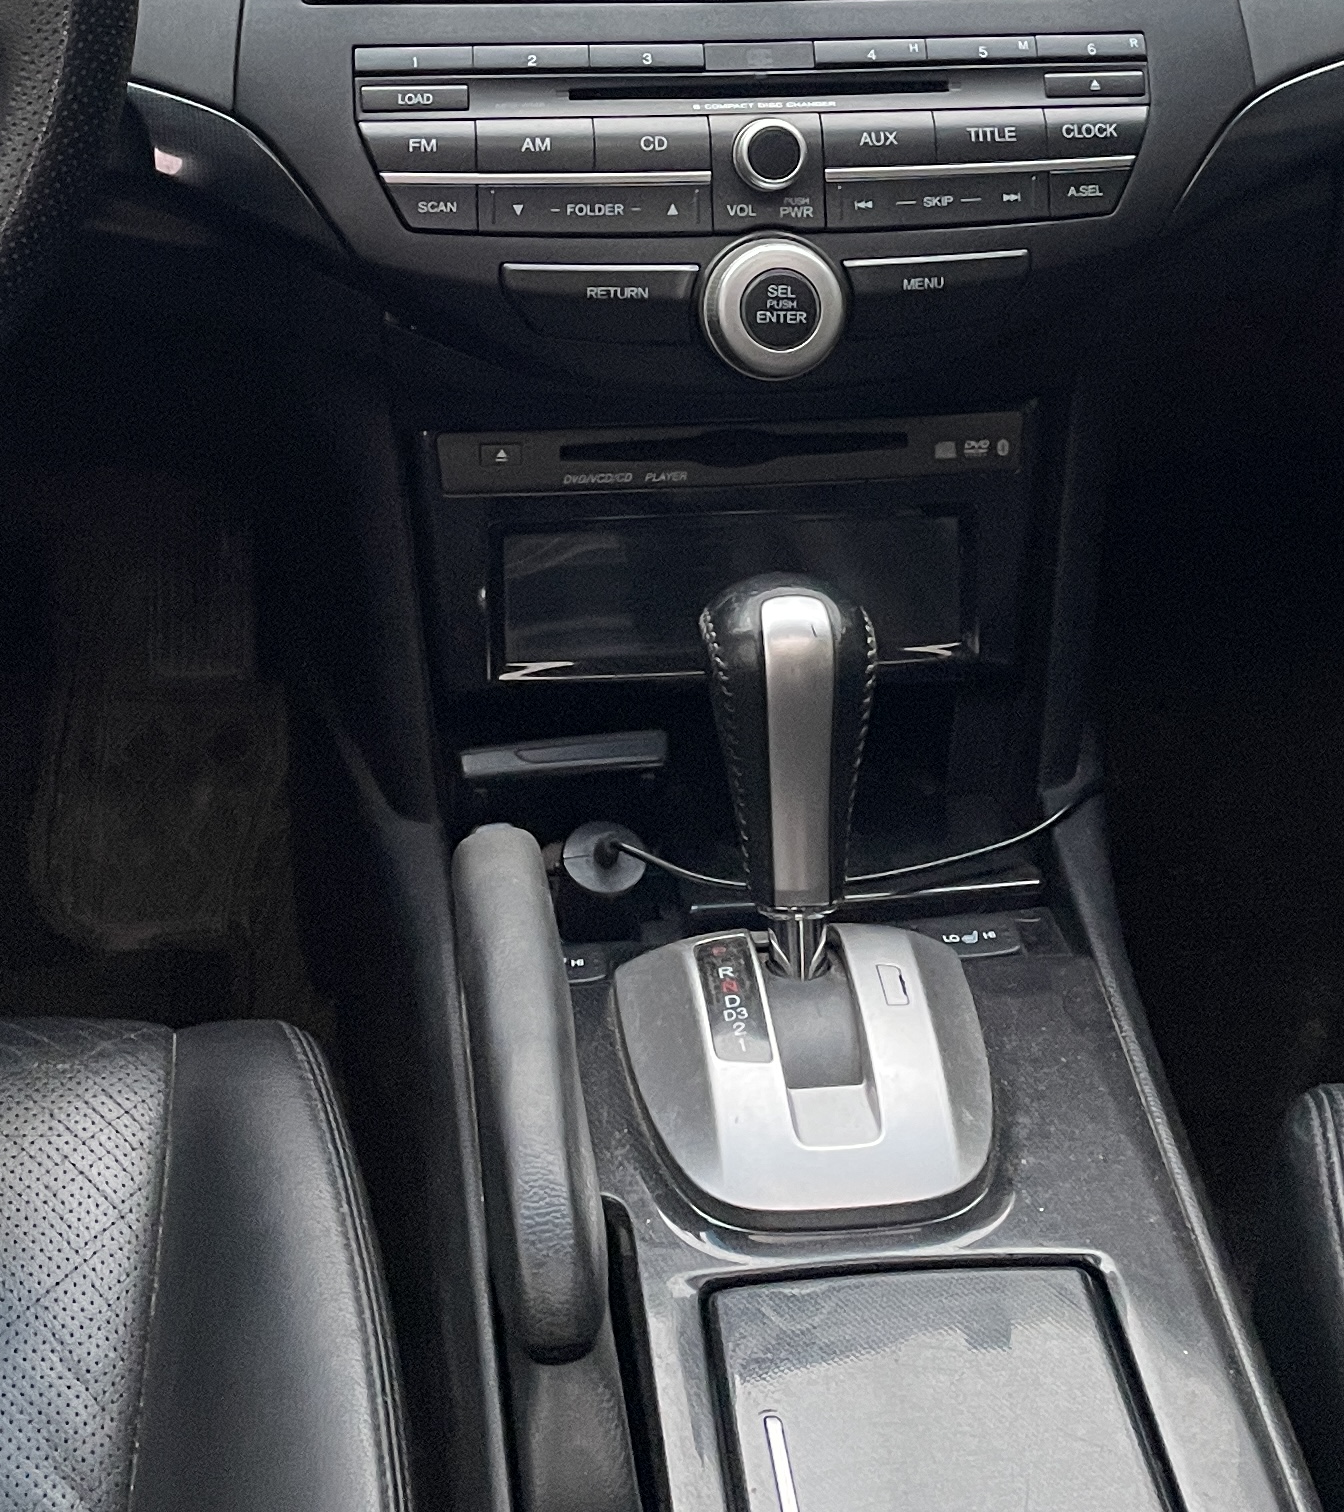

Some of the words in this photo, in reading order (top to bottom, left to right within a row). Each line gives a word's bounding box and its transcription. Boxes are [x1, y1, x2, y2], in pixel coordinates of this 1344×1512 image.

[908, 43, 919, 54] H
[1018, 40, 1029, 51] M
[1087, 43, 1096, 55] 6
[1129, 37, 1139, 49] R
[642, 53, 653, 65] 3
[867, 49, 876, 60] 4
[978, 46, 988, 59] 5
[412, 56, 418, 67] 1
[527, 54, 537, 67] 2
[397, 92, 433, 106] LOAD
[705, 102, 754, 110] COMPACT
[786, 100, 837, 108] CHANGER
[966, 126, 1017, 143] TITLE
[1061, 123, 1118, 139] CLOCK
[408, 138, 437, 152] FM
[521, 137, 551, 152] AM
[640, 136, 668, 151] CD
[859, 131, 898, 146] AUX
[417, 200, 457, 213] SCAN
[783, 196, 810, 206] PUSH
[923, 195, 954, 208] SKIP
[566, 203, 624, 216] FOLDER
[726, 204, 757, 217] VOL
[779, 206, 814, 218] PWR
[903, 276, 945, 291] MENU
[586, 287, 649, 300] RETURN
[766, 284, 797, 298] SEL
[766, 299, 797, 309] PUSH
[756, 311, 807, 324] ENTER
[644, 470, 688, 483] PLAYER
[718, 966, 735, 979] R
[724, 994, 741, 1008] D
[722, 1007, 749, 1022] D3
[732, 1021, 747, 1037] 2
[739, 1037, 747, 1053] 1
